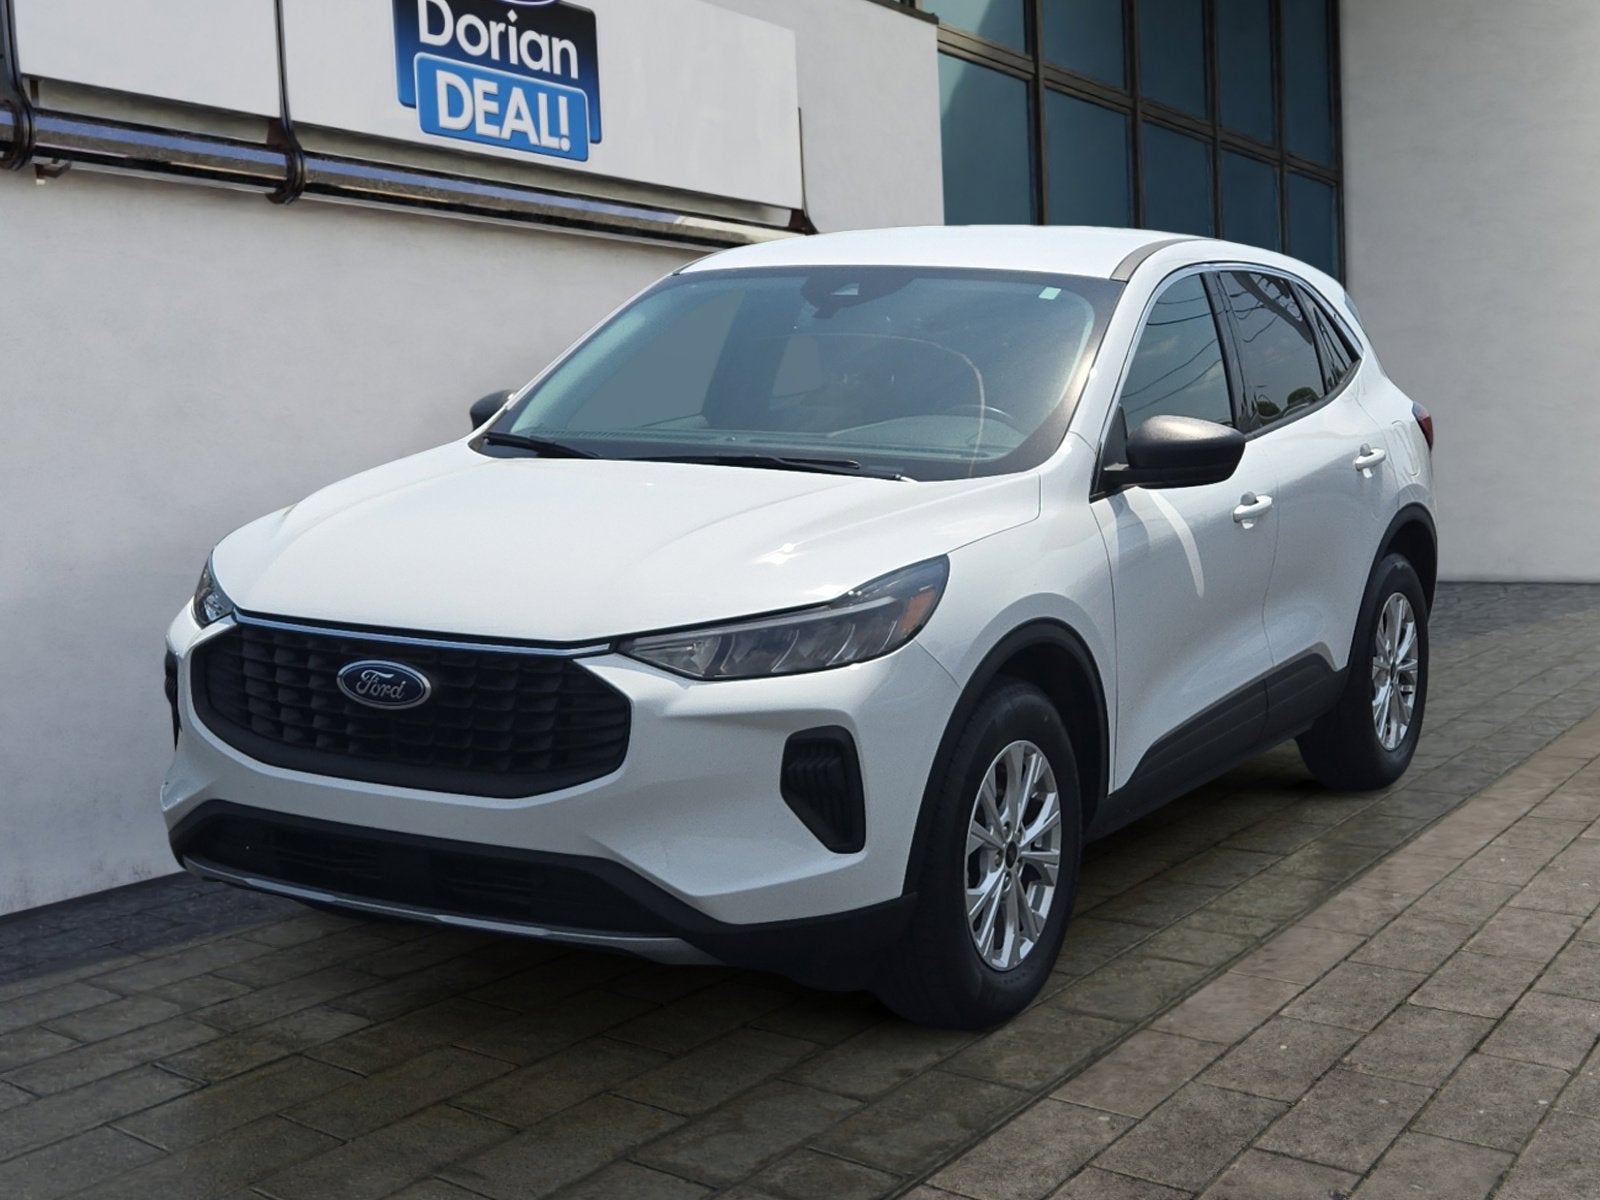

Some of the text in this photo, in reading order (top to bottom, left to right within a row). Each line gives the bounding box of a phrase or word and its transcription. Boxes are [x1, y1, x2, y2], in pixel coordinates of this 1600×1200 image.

[418, 0, 579, 80] Dorian
[436, 69, 572, 152] DEAL!
[356, 669, 407, 699] Ford
